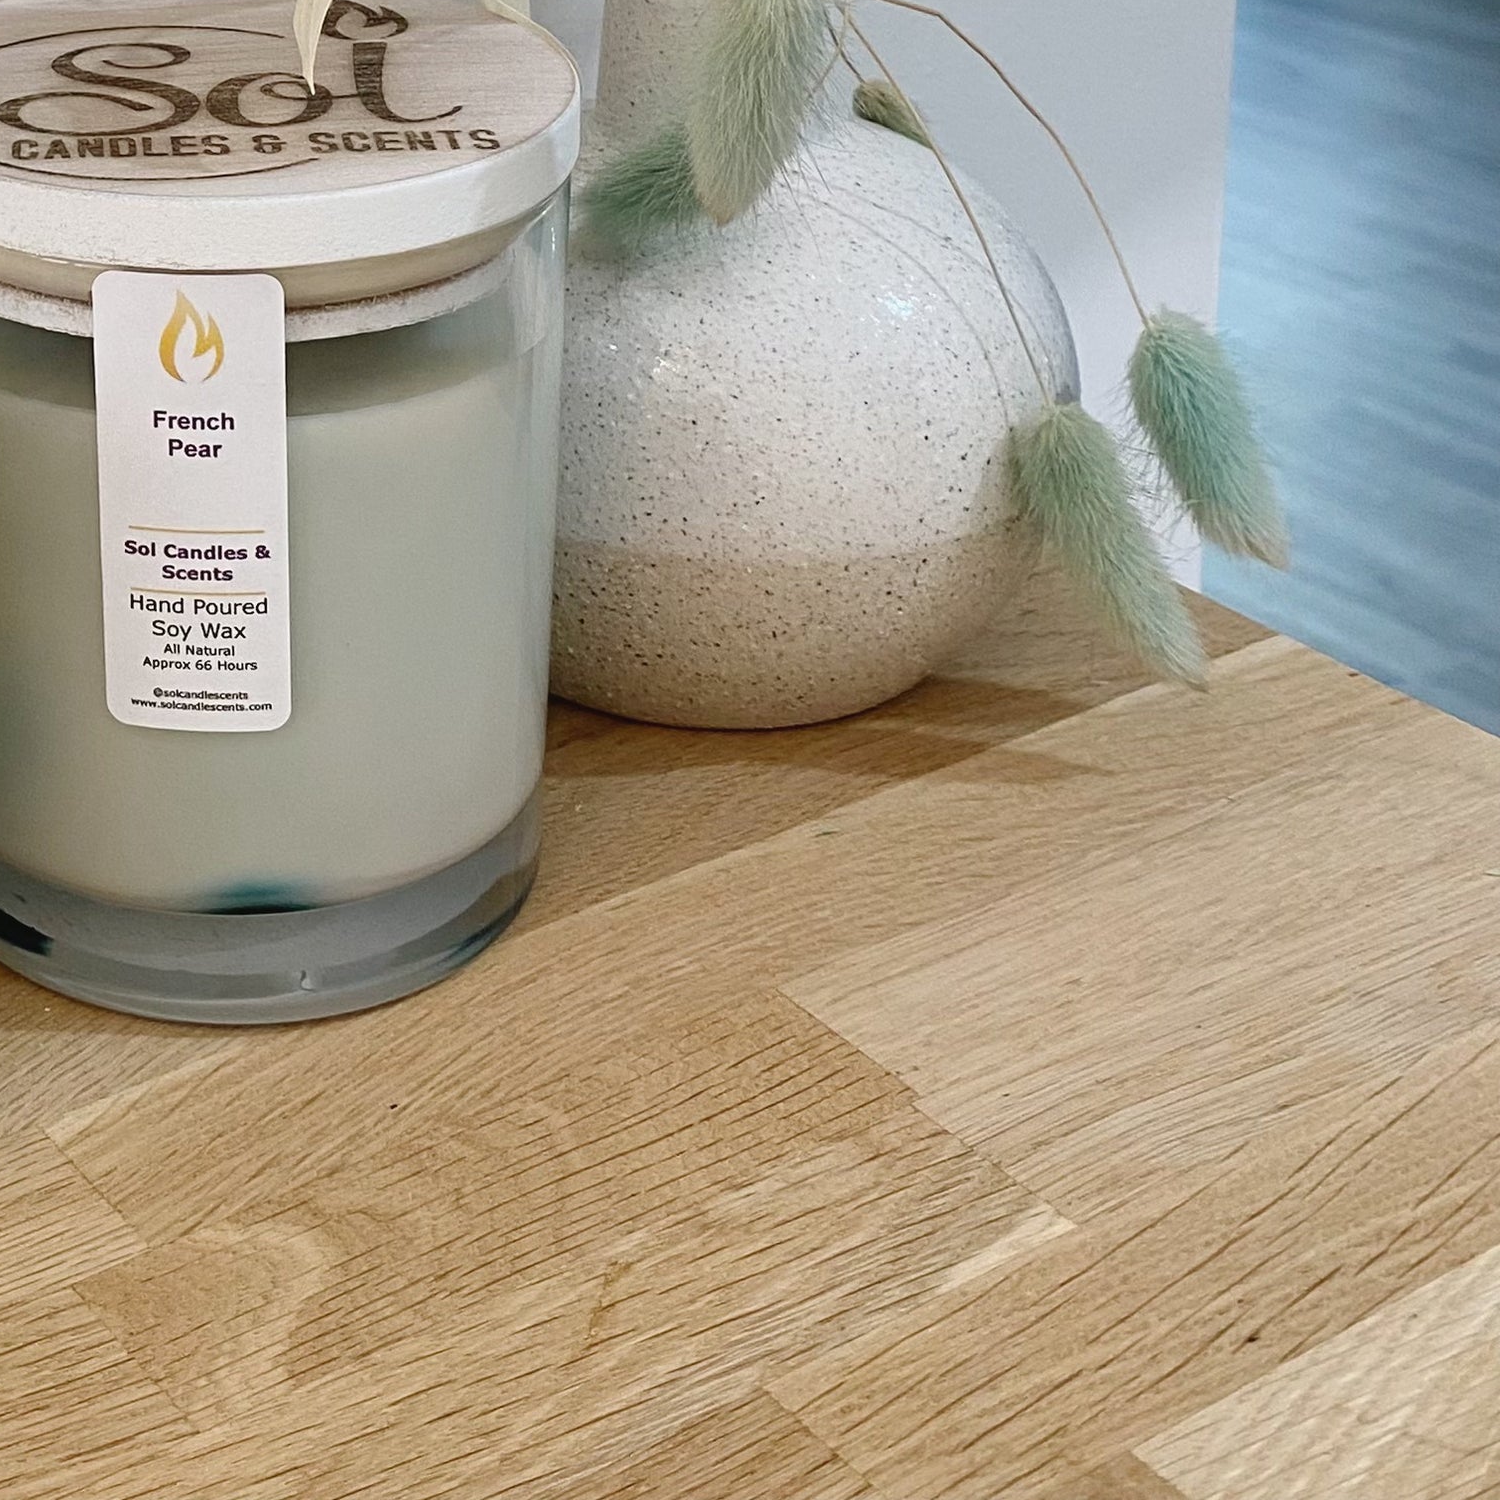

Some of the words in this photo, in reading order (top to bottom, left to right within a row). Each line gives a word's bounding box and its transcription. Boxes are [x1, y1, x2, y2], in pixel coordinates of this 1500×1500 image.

[11, 134, 229, 160] CANDLES
[252, 134, 285, 155] &
[308, 129, 501, 153] SCENTS
[153, 410, 235, 431] French
[168, 438, 222, 458] Pear
[124, 540, 156, 557] Sol
[163, 544, 248, 560] Candles
[255, 545, 271, 559] &
[162, 565, 233, 581] Scents
[130, 593, 184, 614] Hand
[194, 598, 268, 615] Poured
[152, 620, 192, 641] Soy
[200, 622, 246, 639] Wax
[163, 644, 180, 654] All
[185, 645, 235, 656] Natural
[143, 657, 190, 670] Approx
[195, 660, 212, 670] 66
[218, 660, 258, 671] Hours
[153, 687, 248, 700] @solcandlescents
[131, 698, 272, 711] www.solcandlescents.com
